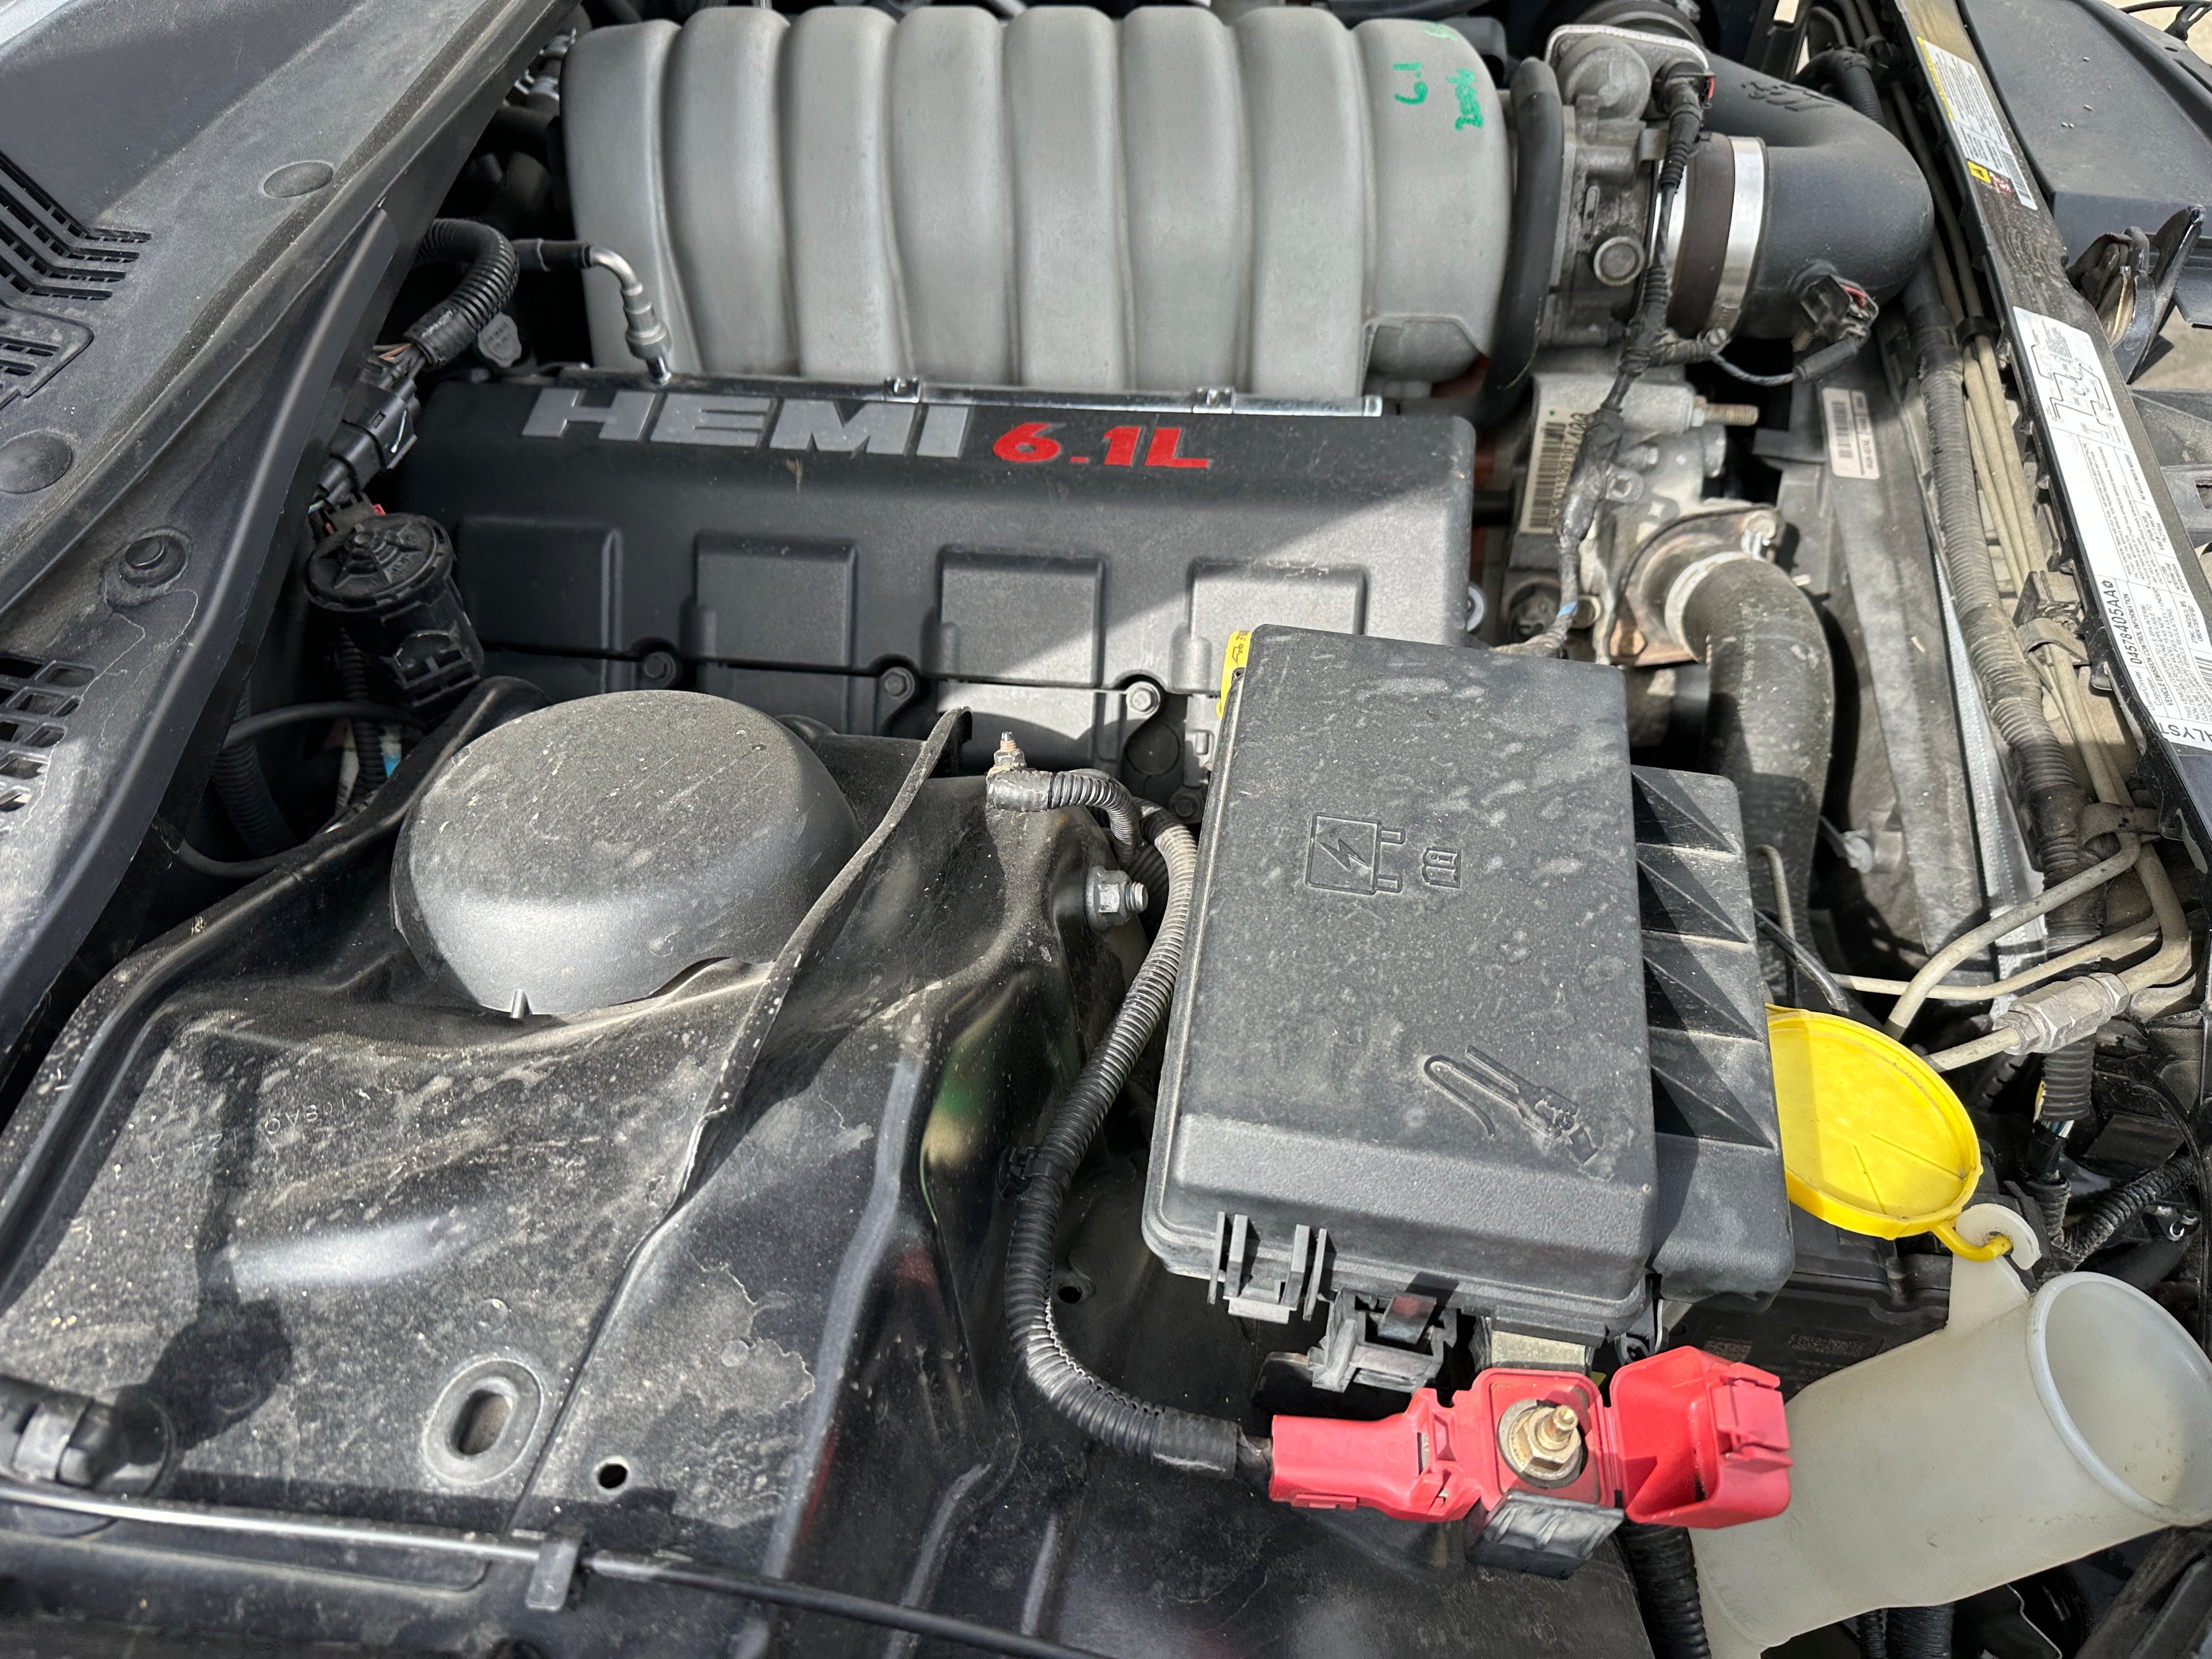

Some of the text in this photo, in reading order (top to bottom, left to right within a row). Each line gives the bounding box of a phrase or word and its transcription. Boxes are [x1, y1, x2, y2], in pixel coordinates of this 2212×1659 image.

[522, 388, 1210, 468] HEMI 6.1L
[2104, 588, 2142, 664] 04578405AA
[2123, 593, 2173, 705] VEHICLE EMISSION CONTROL INFORMATION
[2147, 677, 2162, 706] Corporation
[2173, 684, 2188, 704] VEHICLE
[2184, 706, 2192, 718] THIS
